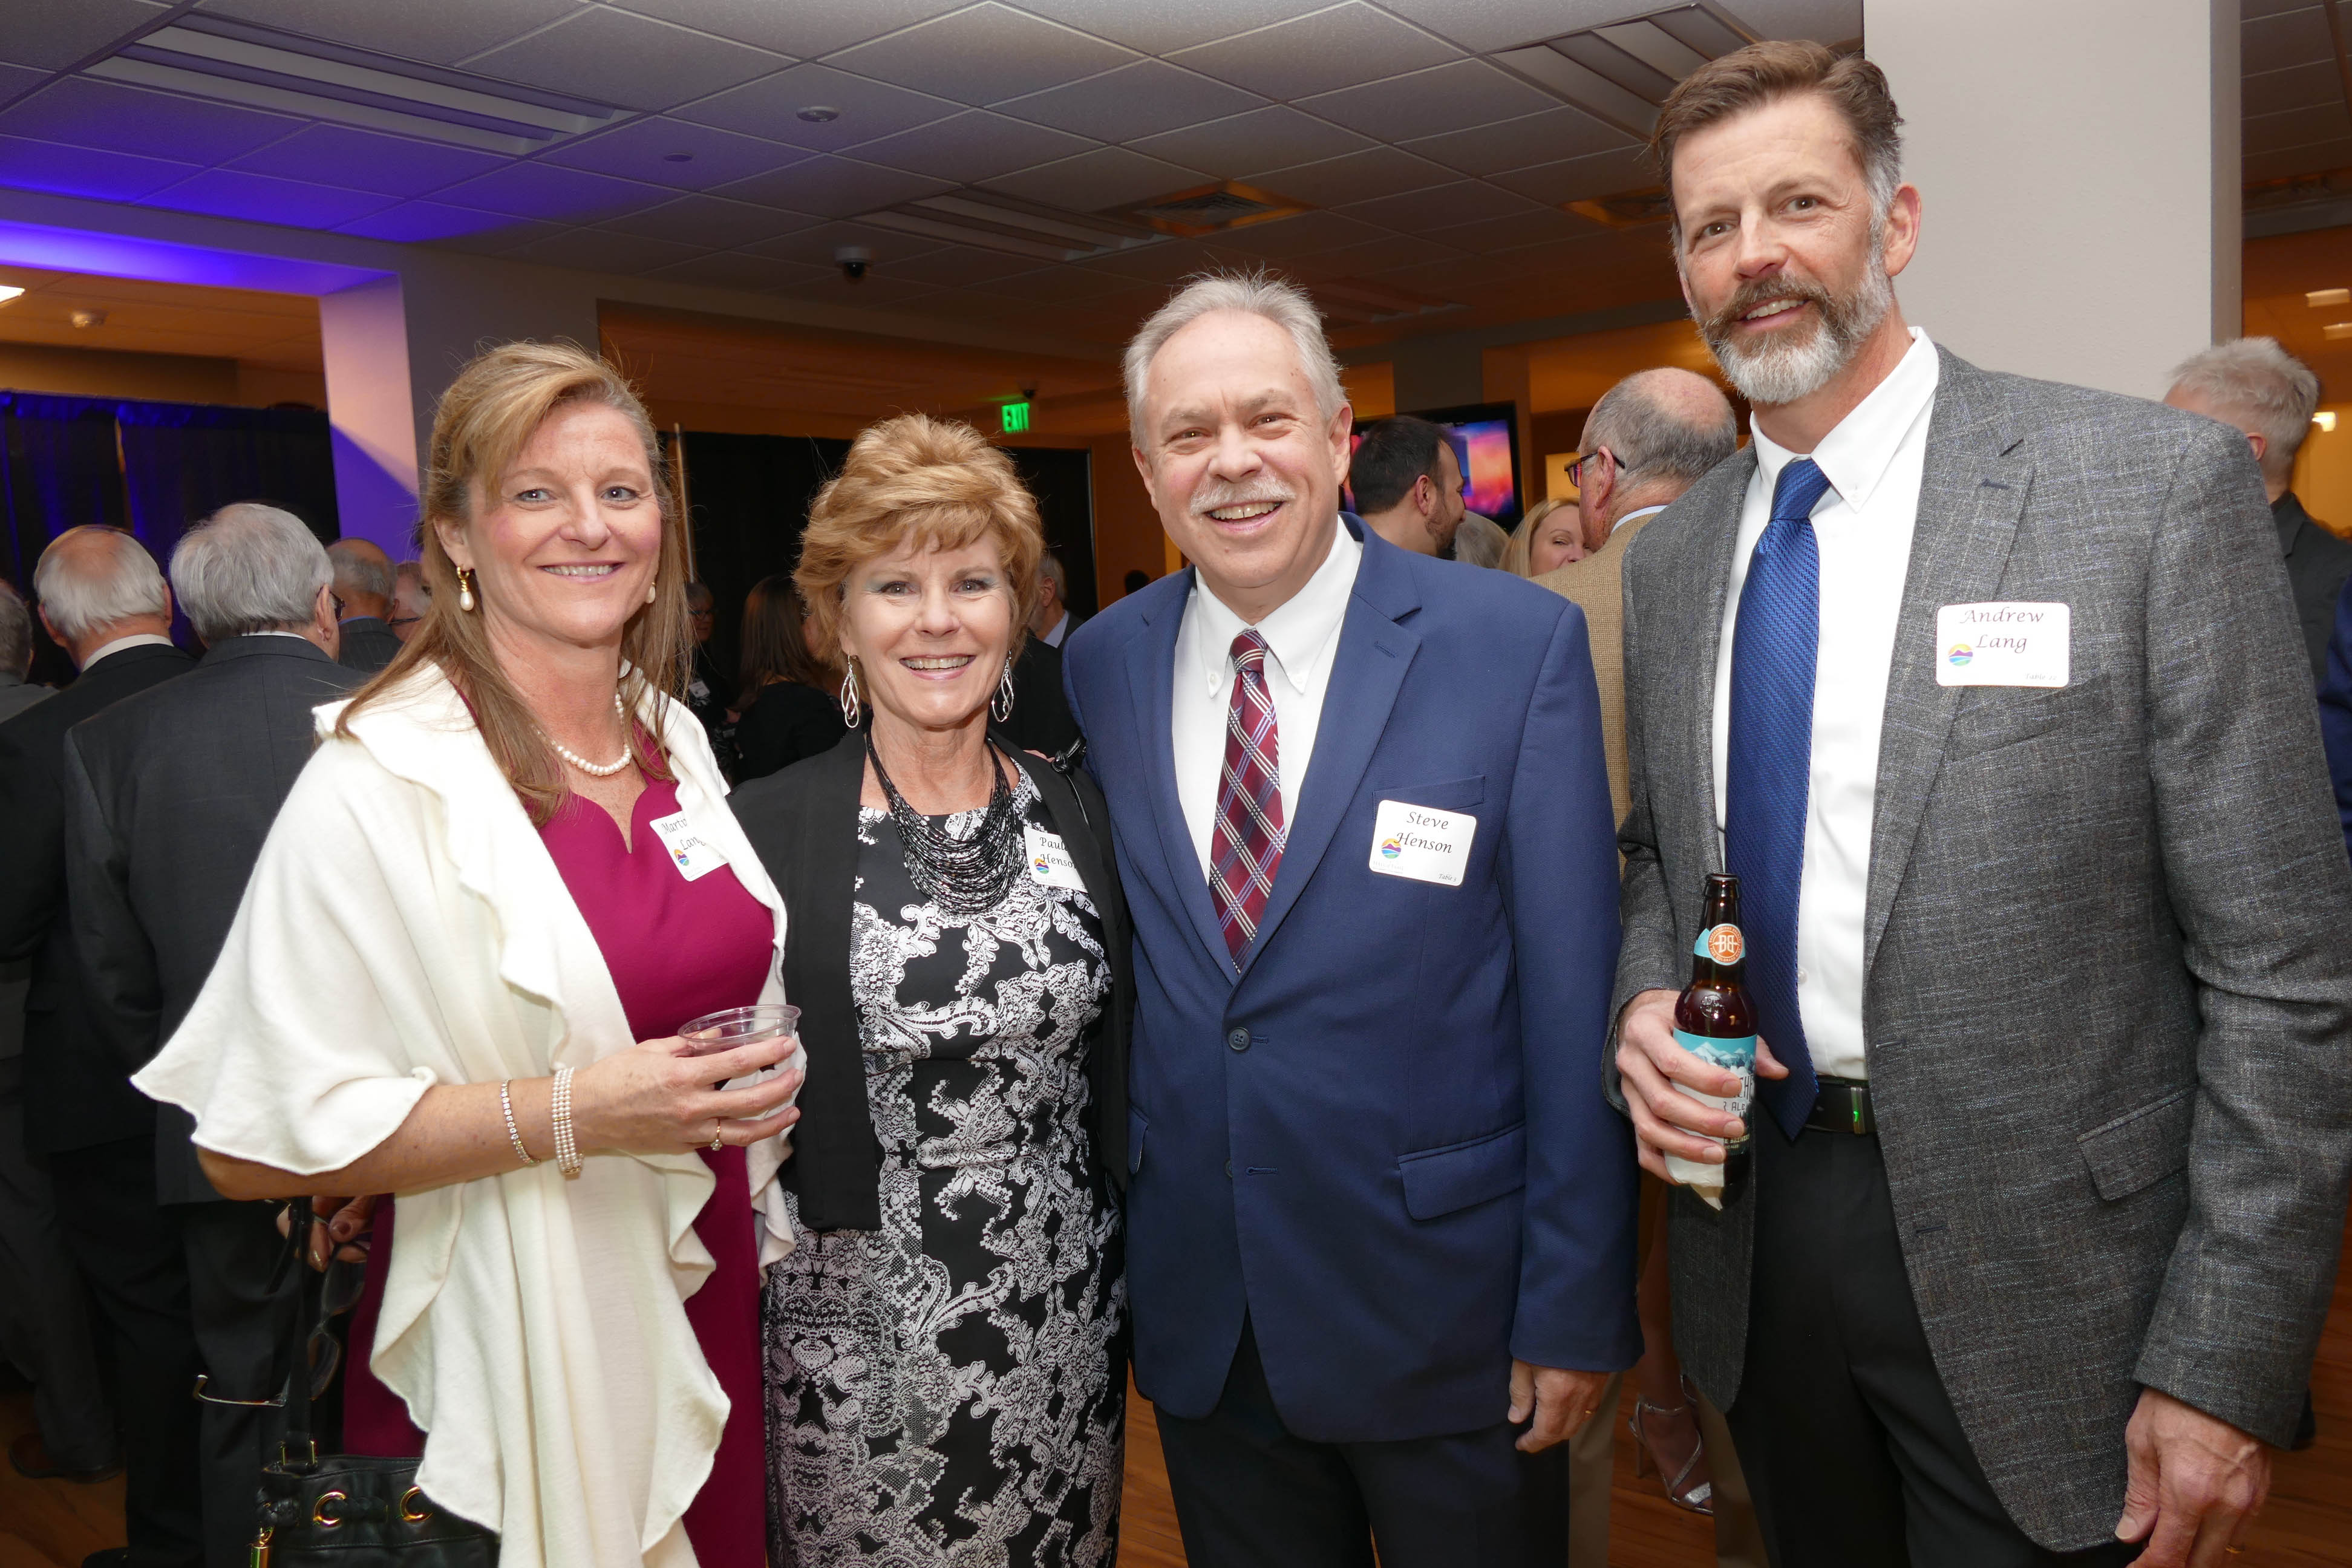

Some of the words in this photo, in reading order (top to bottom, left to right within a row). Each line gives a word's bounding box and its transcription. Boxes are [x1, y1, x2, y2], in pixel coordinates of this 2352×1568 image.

[1002, 402, 1030, 433] EXIT
[1959, 606, 2044, 624] Andrew
[1976, 634, 2028, 654] Lang
[1406, 811, 1449, 830] Steve
[1394, 832, 1452, 854] Henson
[1040, 853, 1074, 868] Henso
[1731, 1102, 1745, 1111] ALE
